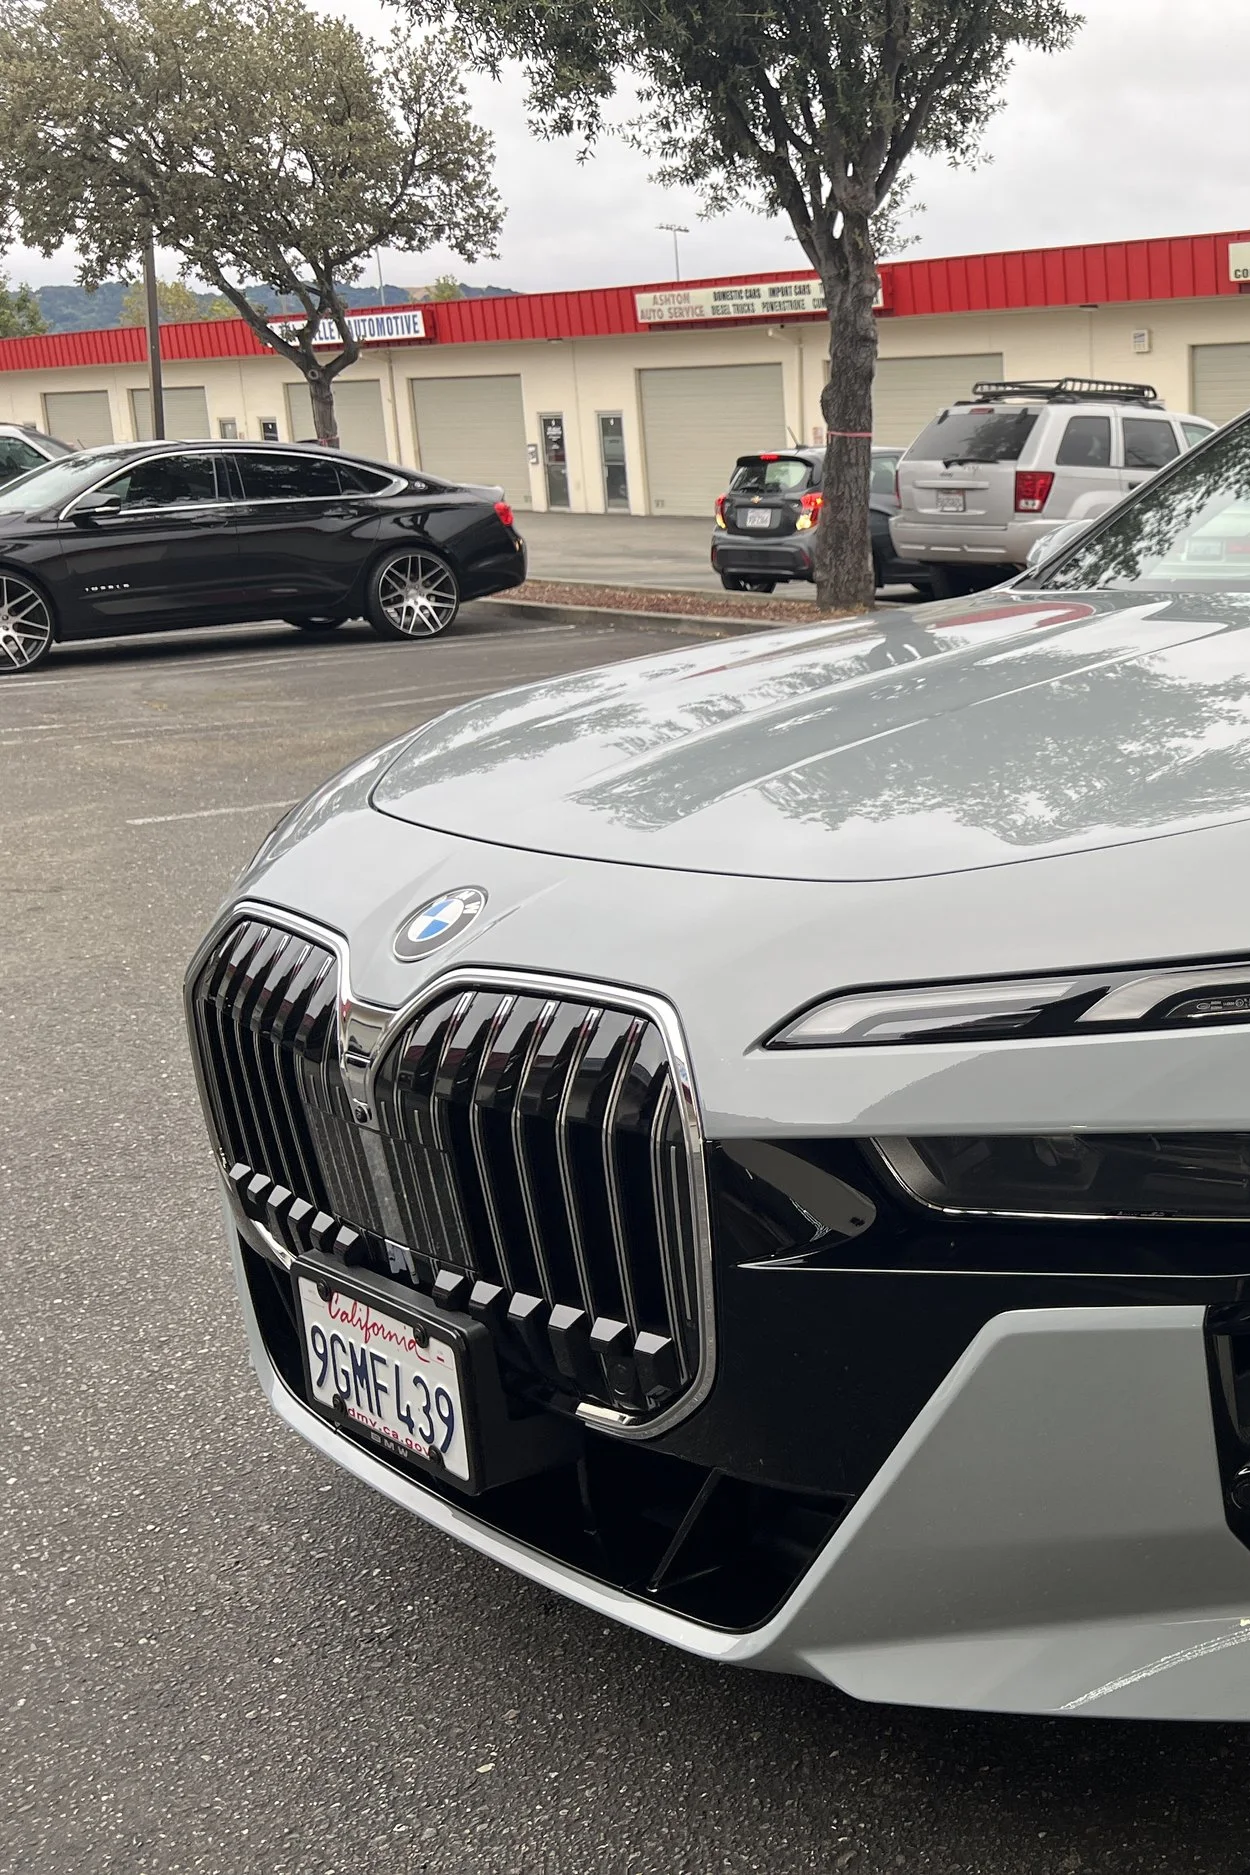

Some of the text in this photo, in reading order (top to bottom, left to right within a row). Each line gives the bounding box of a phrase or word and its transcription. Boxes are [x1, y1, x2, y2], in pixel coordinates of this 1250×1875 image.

[652, 292, 691, 307] ASHTON
[713, 289, 743, 302] DOMESTIC
[745, 288, 761, 300] CARS
[768, 285, 793, 298] IMPORT
[640, 305, 705, 321] AUTO SERVICE
[327, 1291, 430, 1363] California
[310, 1324, 455, 1454] 9GMF439
[347, 1407, 431, 1456] dmv.ca.gov
[371, 1431, 409, 1458] BMW
